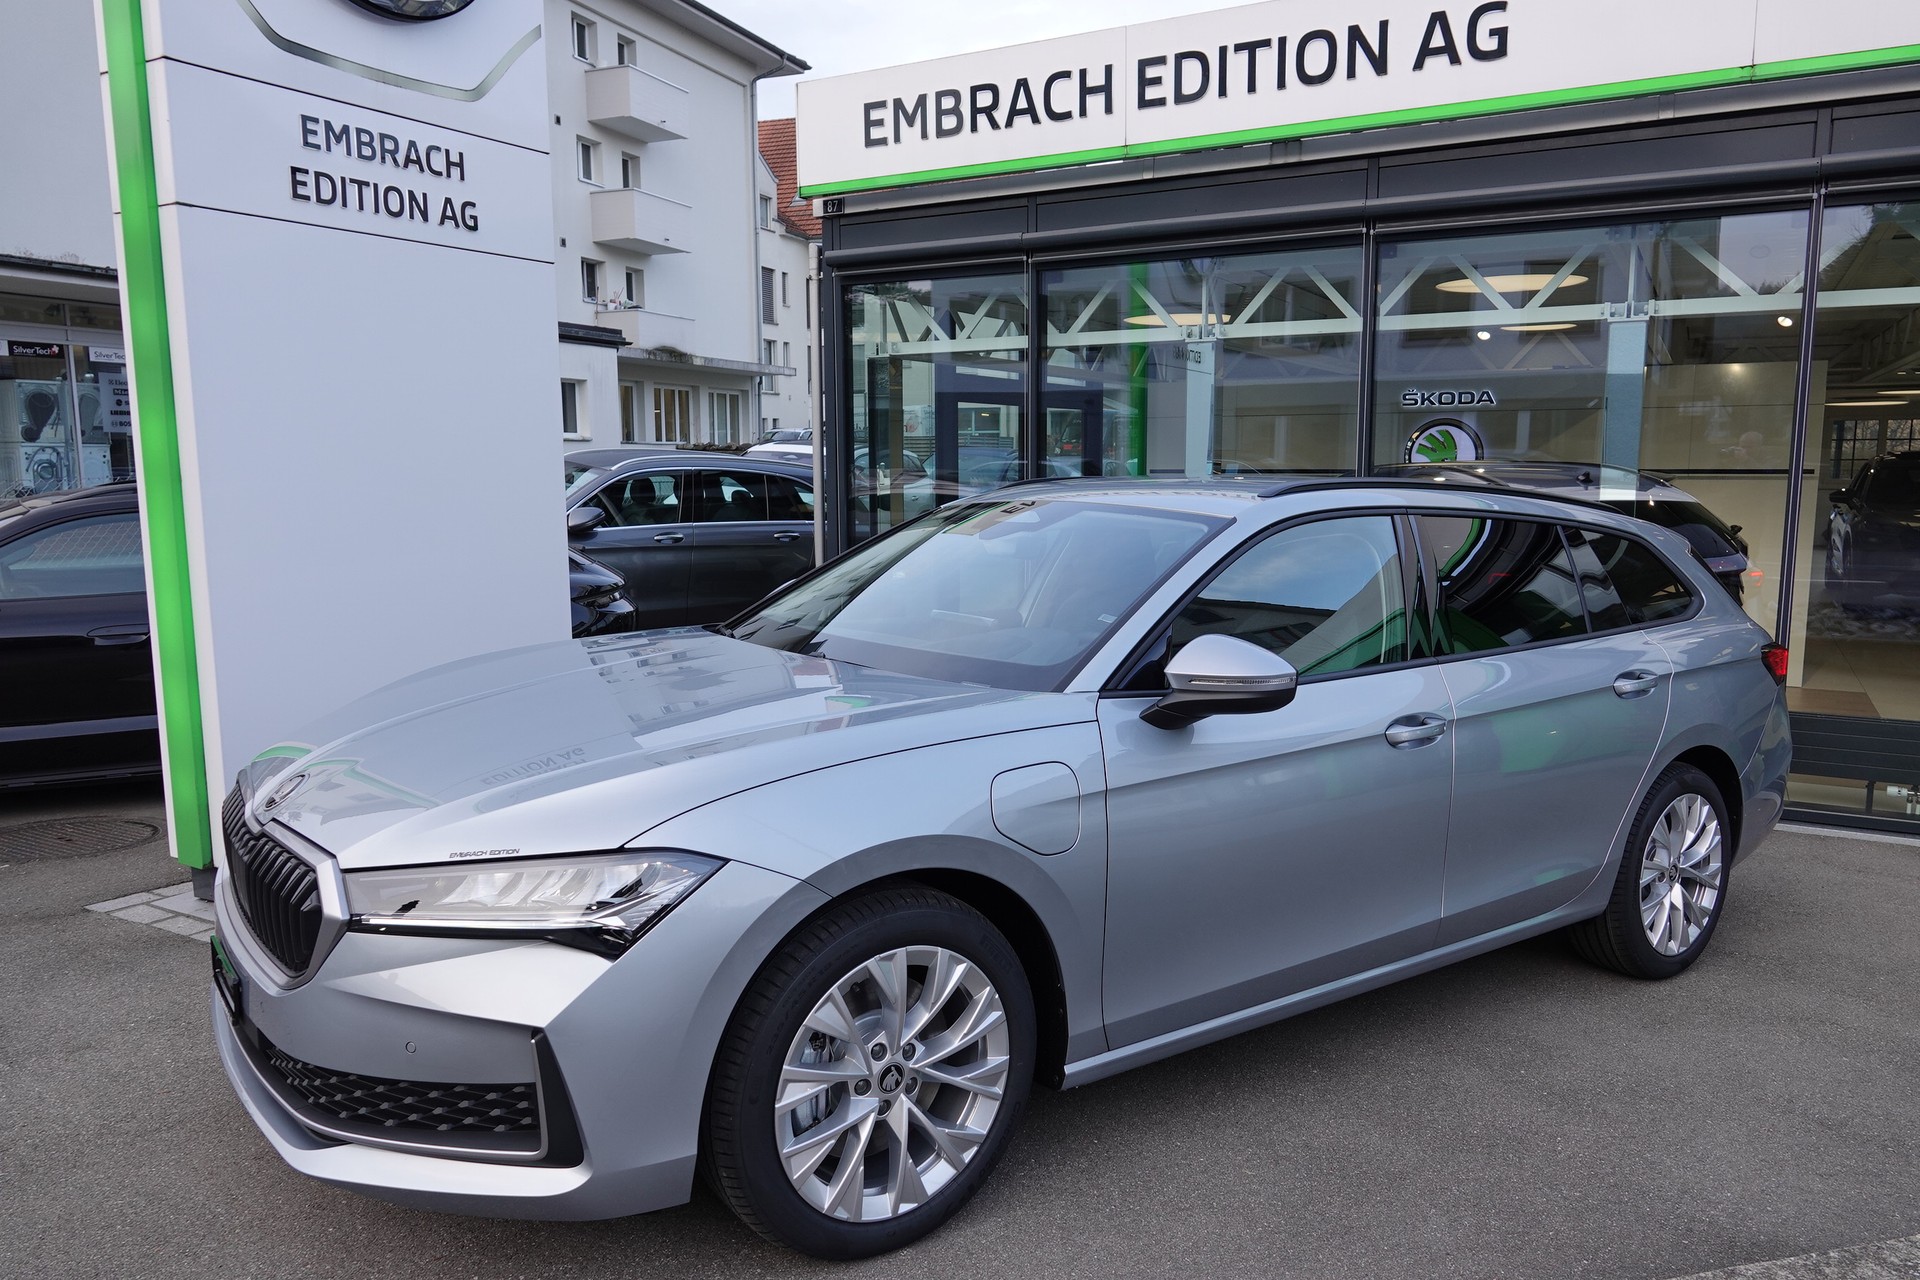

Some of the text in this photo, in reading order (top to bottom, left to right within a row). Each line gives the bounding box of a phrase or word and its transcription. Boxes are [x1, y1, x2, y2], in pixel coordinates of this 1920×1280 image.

[863, 0, 1510, 148] EMBRACH EDITION AG
[300, 114, 466, 182] EMBRACH
[289, 166, 480, 232] EDITION AG
[827, 200, 838, 213] 87
[1401, 388, 1496, 407] ŠKODA
[489, 848, 520, 856] EDITION
